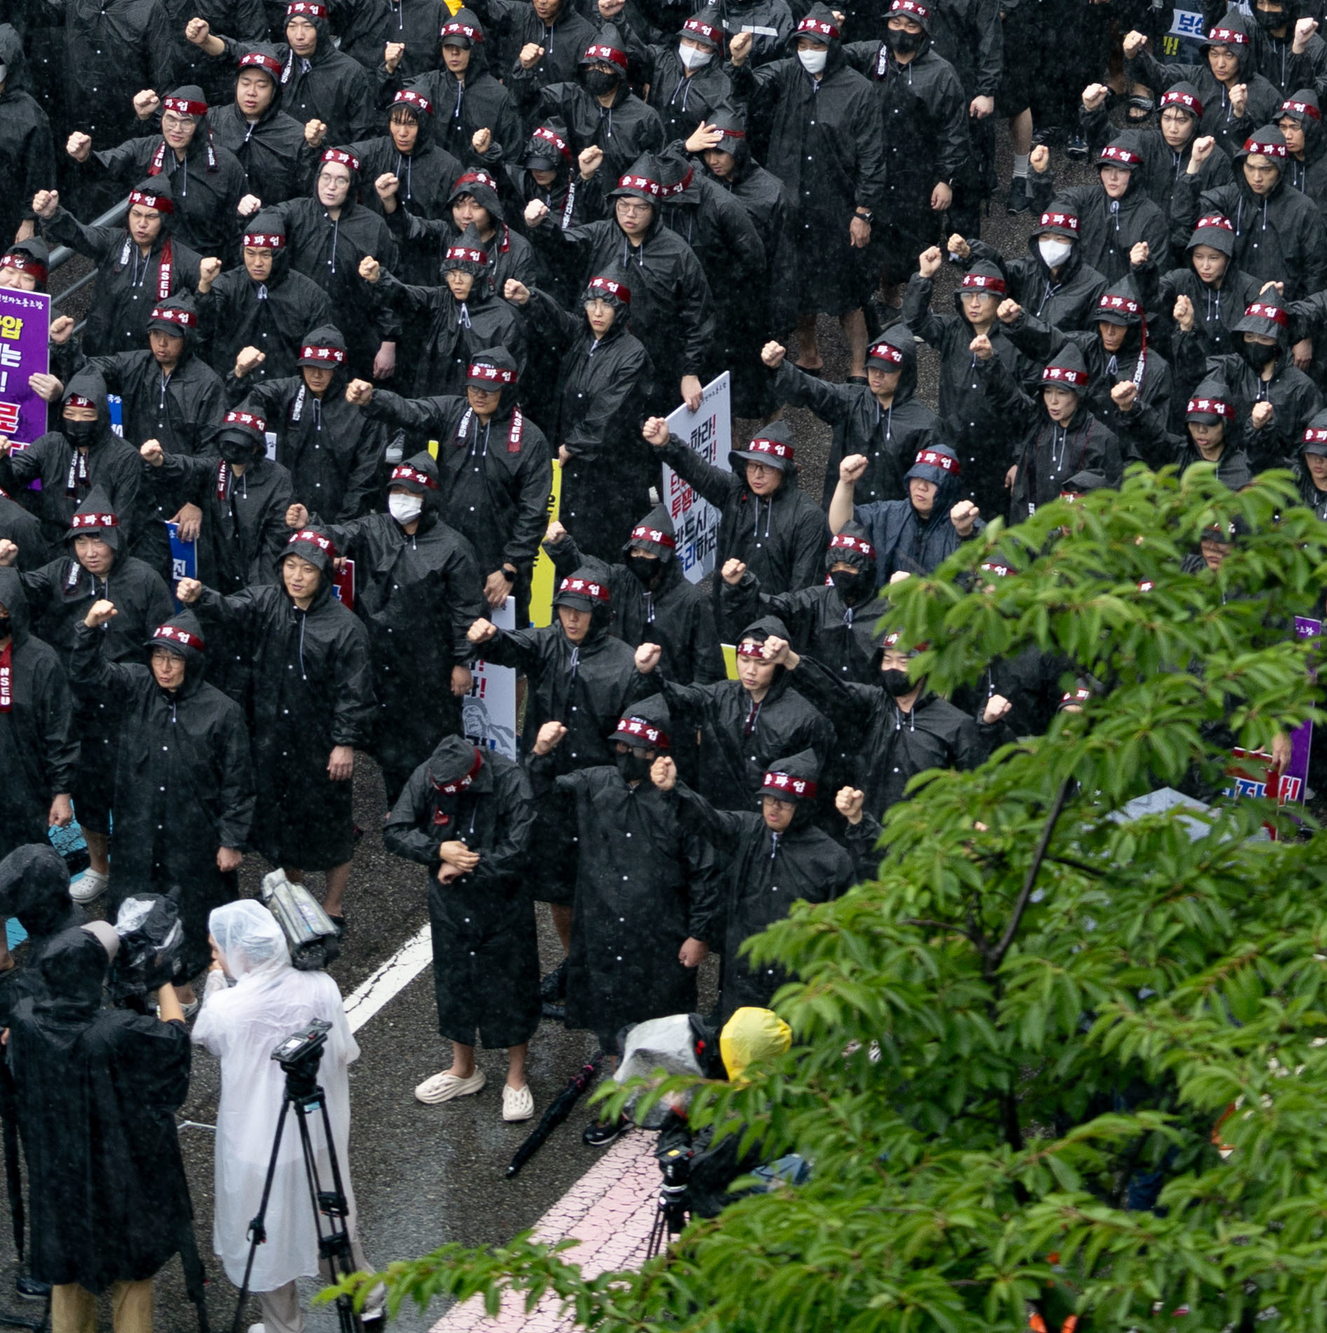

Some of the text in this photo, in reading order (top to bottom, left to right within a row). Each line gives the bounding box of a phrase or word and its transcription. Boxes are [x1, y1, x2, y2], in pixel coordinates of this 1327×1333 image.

[129, 191, 155, 206] 파업
[446, 249, 480, 261] 파업
[160, 264, 170, 298] NSEU
[588, 278, 619, 292] 파업
[0, 294, 44, 310] 전자노동조합
[1245, 304, 1277, 317] 파업
[0, 315, 24, 340] 압
[0, 342, 21, 368] 는
[510, 409, 521, 444] NSEU
[632, 527, 662, 541] 파업
[153, 627, 190, 643] 파업
[0, 668, 10, 706] NSEU
